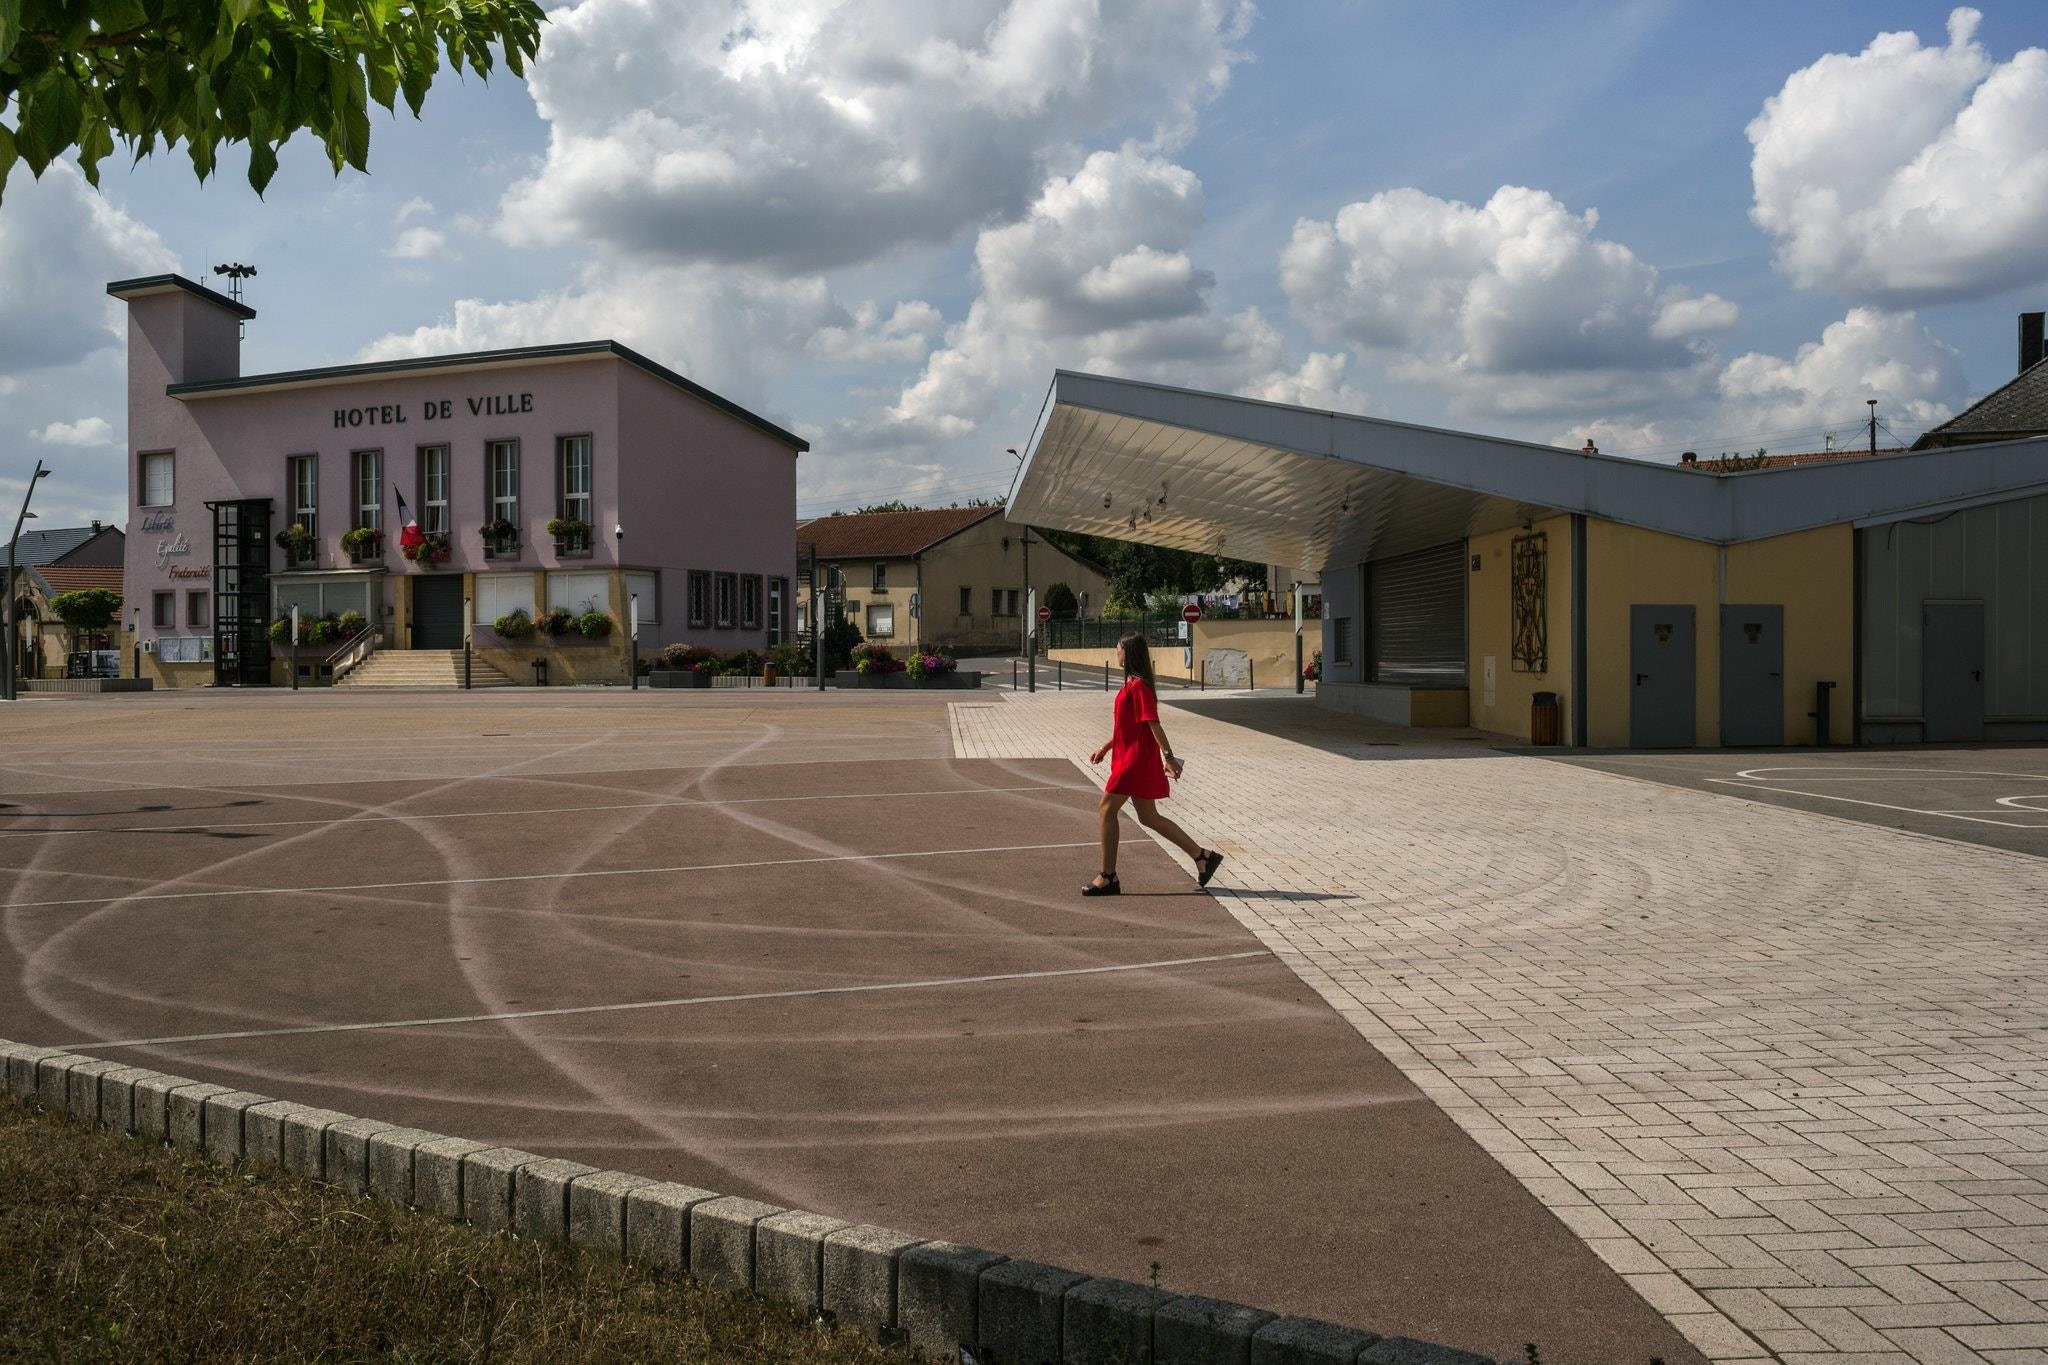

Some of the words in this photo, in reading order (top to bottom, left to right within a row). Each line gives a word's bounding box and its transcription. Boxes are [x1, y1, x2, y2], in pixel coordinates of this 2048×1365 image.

[334, 404, 406, 428] HOTEL
[424, 400, 453, 420] DE
[467, 393, 534, 416] VILLE
